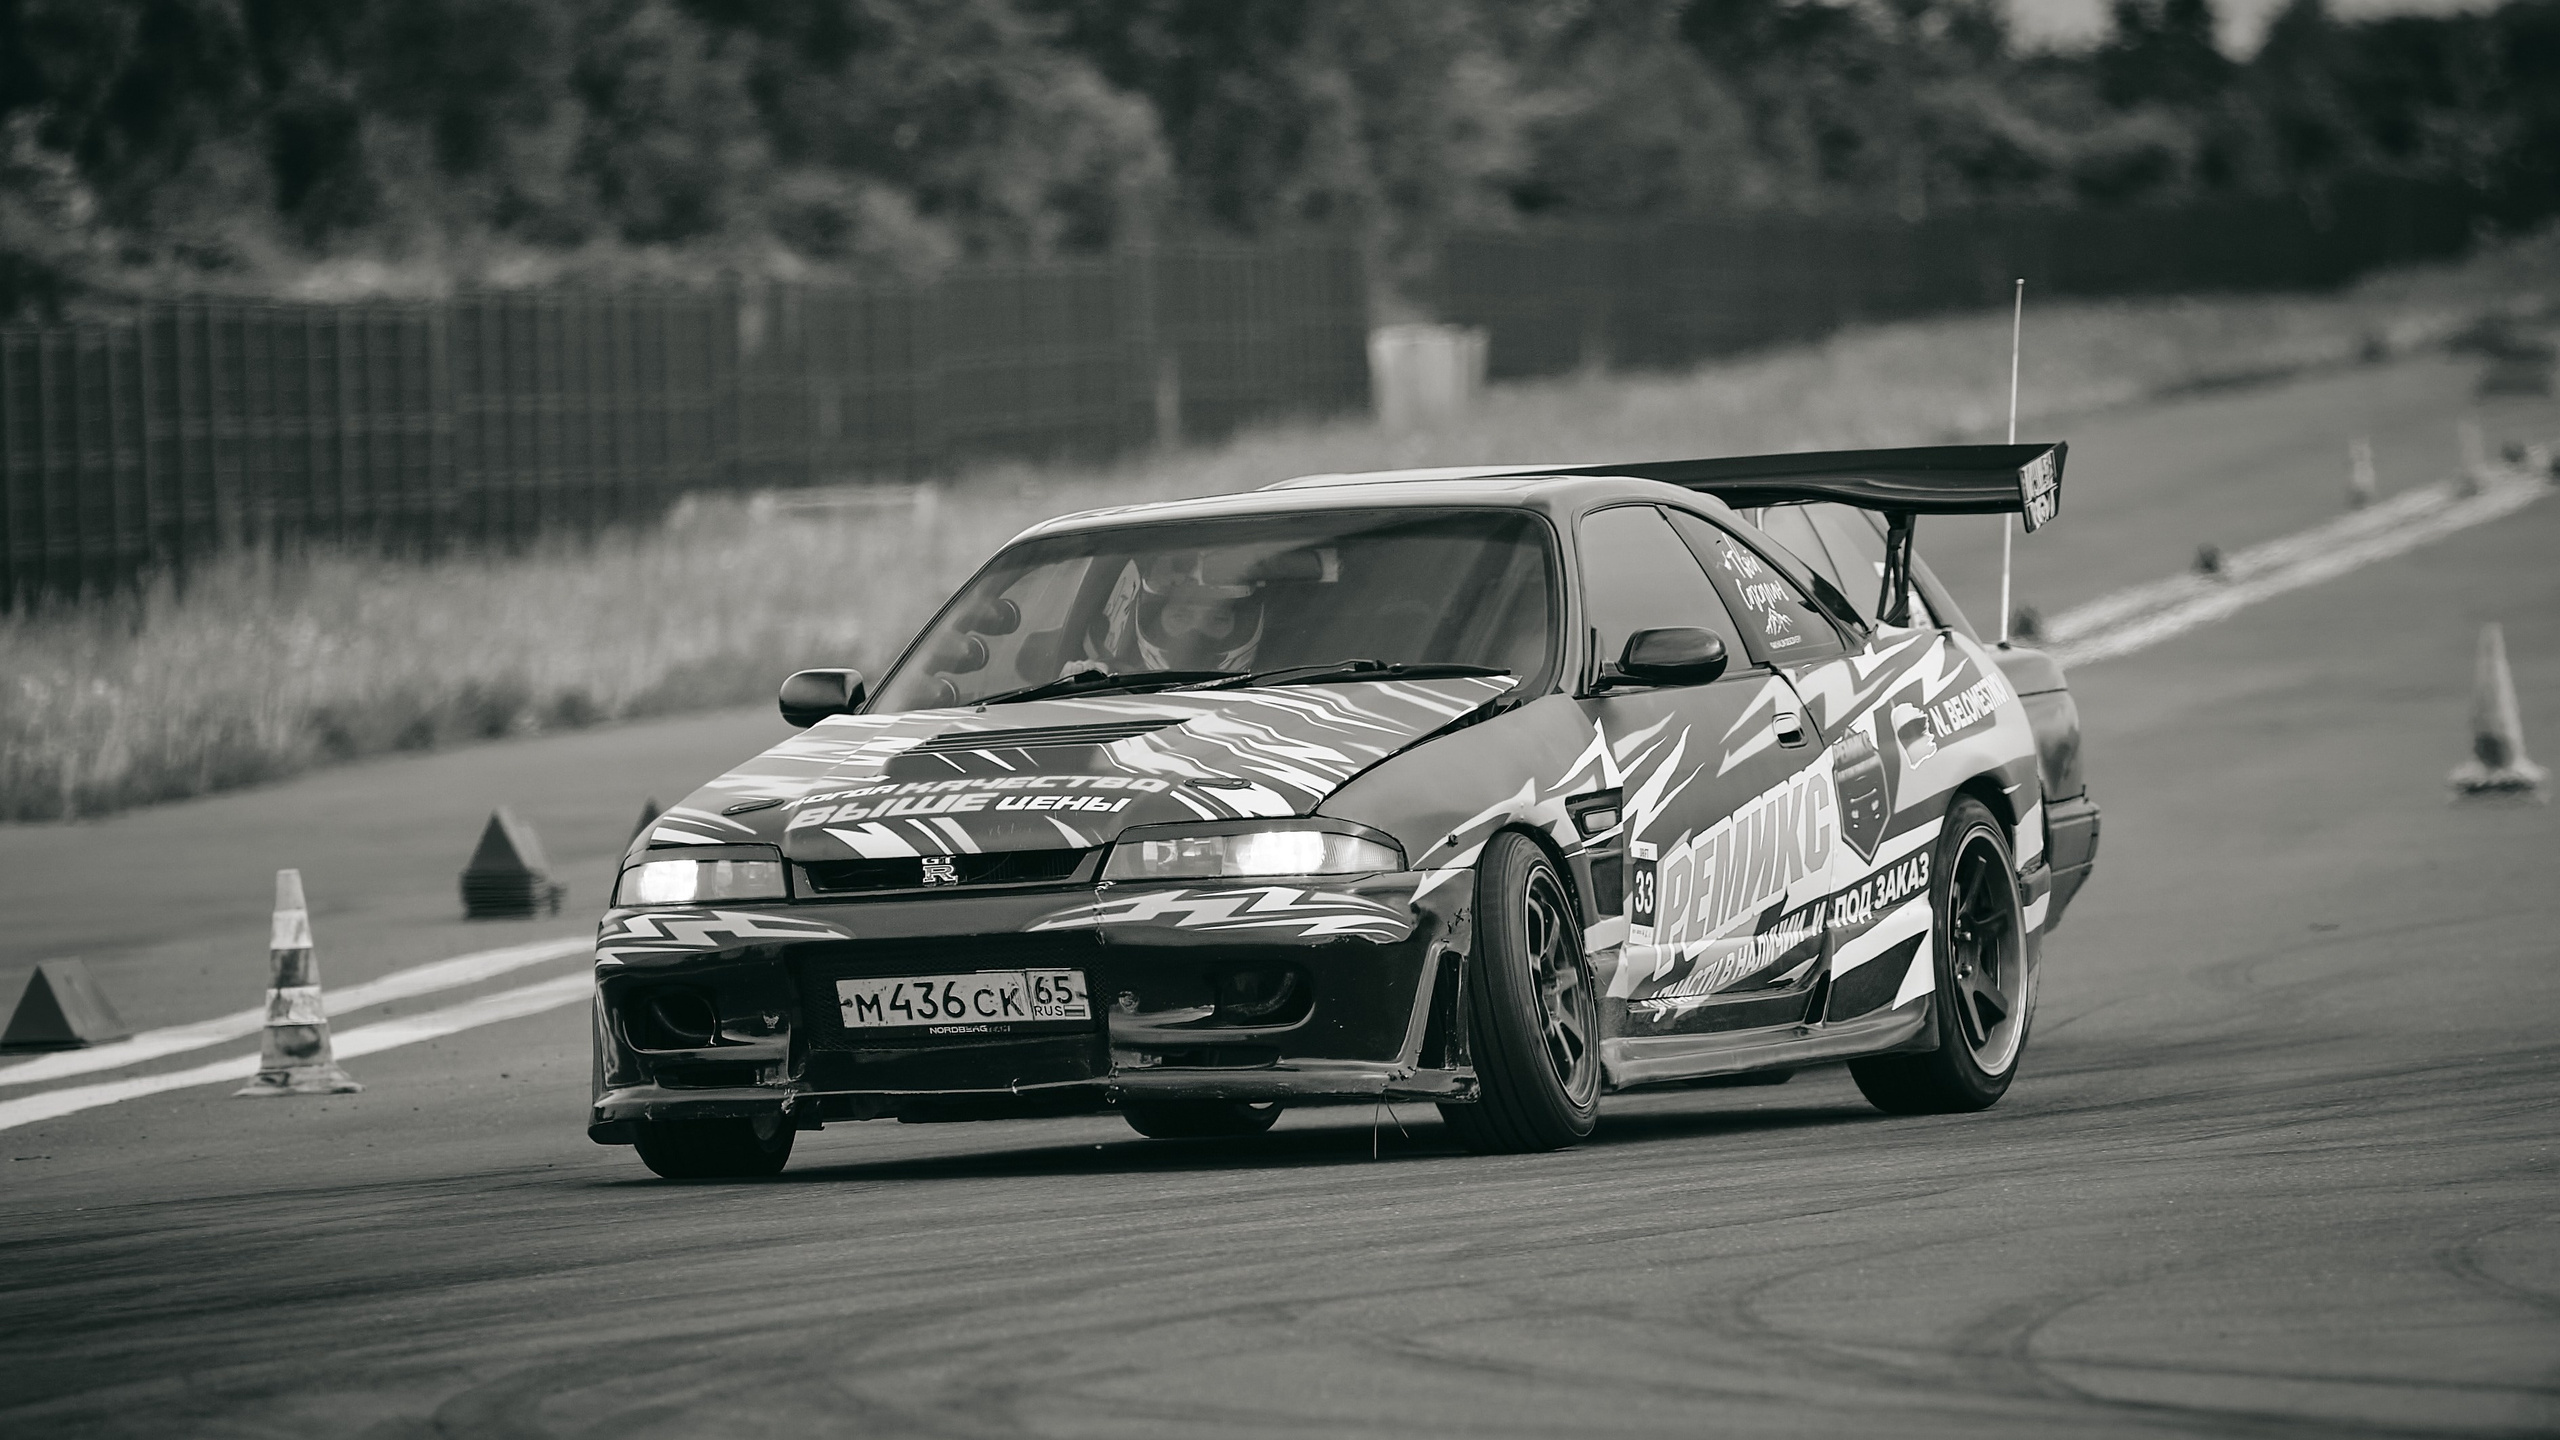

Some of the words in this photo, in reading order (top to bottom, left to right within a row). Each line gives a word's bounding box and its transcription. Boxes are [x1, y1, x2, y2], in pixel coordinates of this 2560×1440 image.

[1929, 705, 1952, 738] N.
[894, 775, 1170, 795] КАЧЕСТВО
[784, 792, 999, 832] ВЫШЕ
[995, 795, 1132, 813] ЦЕНЫ
[922, 856, 956, 864] GT
[923, 865, 958, 882] R
[1654, 769, 1831, 979] РЕМИКС
[1635, 870, 1654, 914] 33
[1717, 952, 1735, 986] В
[1731, 909, 1807, 980] НАЛИЧИИ
[1812, 901, 1827, 936] И
[1834, 881, 1873, 928] ПОД
[1875, 852, 1930, 910] ЗАКАЗ
[1034, 975, 1073, 1004] 65
[1034, 1005, 1064, 1017] RUS
